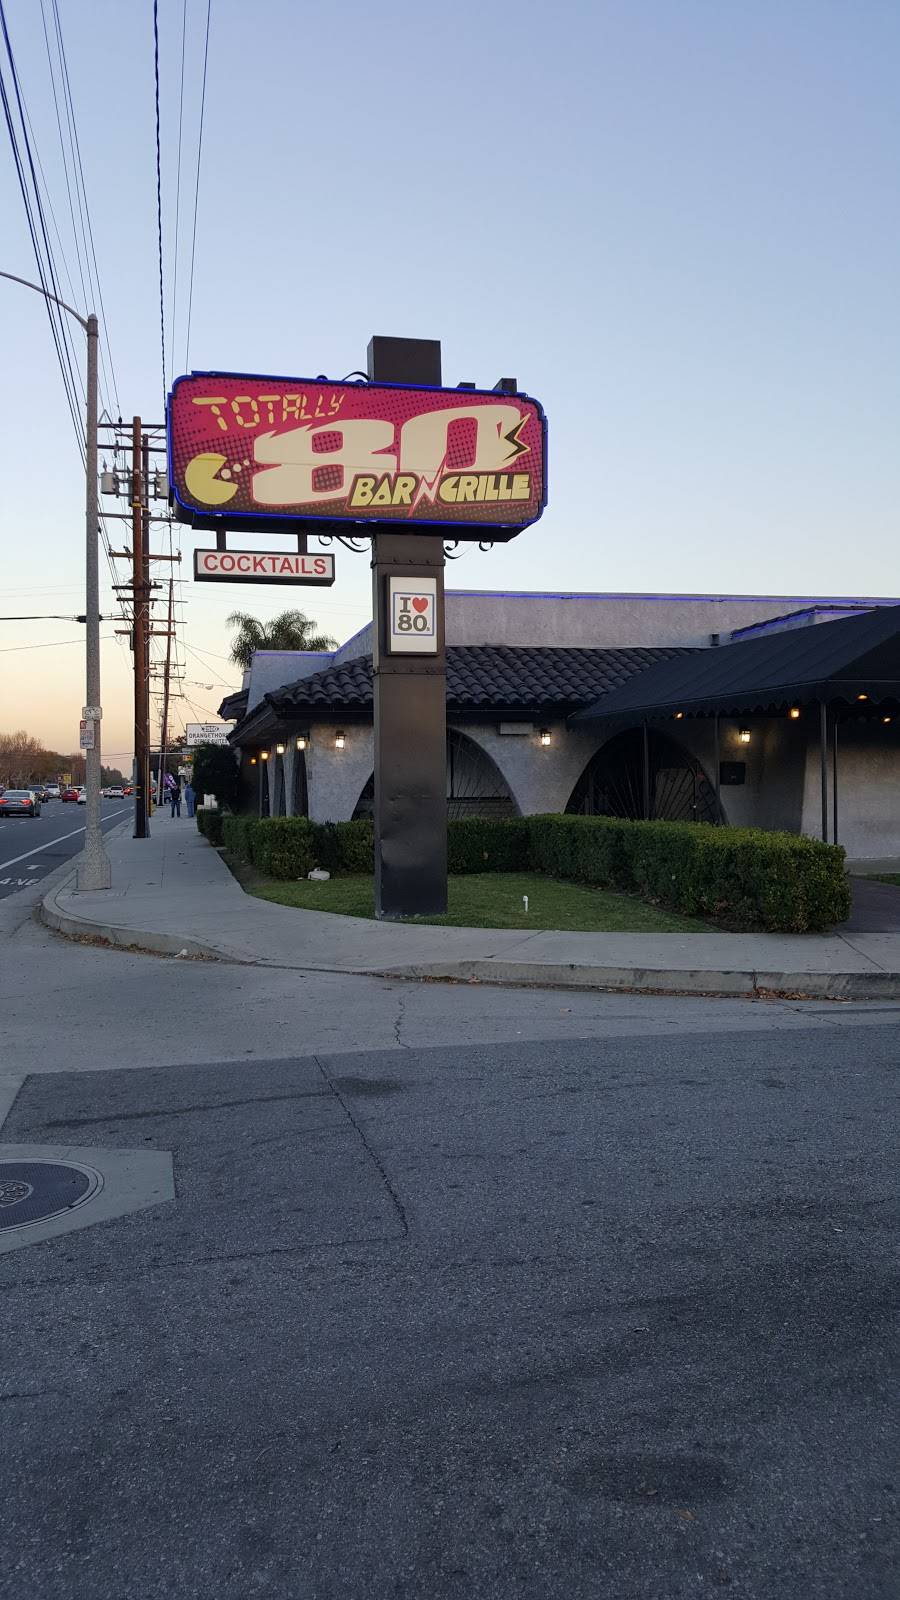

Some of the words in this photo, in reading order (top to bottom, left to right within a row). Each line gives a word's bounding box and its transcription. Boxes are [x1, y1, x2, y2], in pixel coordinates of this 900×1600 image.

[191, 394, 346, 432] TOTALLY
[350, 475, 417, 507] BAR
[438, 474, 532, 503] GRILLE
[203, 554, 327, 575] COCKTAILS
[399, 596, 411, 614] I
